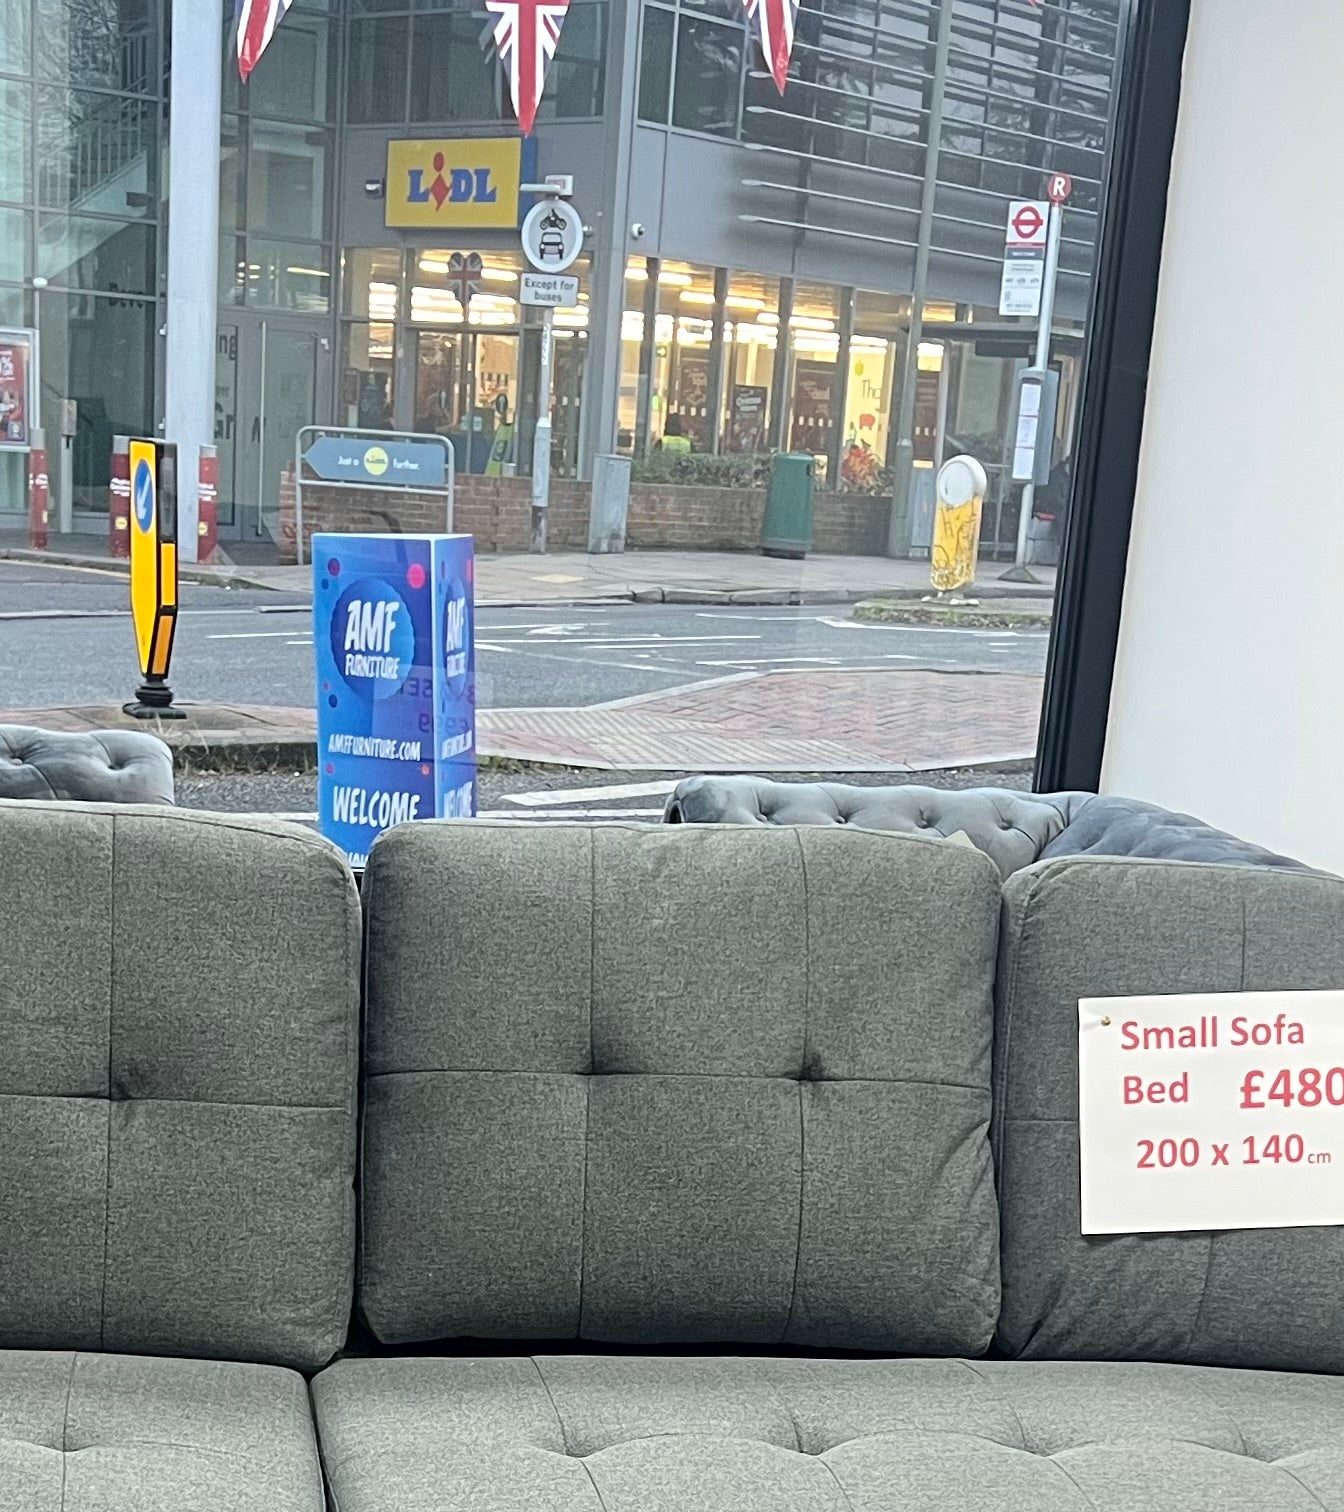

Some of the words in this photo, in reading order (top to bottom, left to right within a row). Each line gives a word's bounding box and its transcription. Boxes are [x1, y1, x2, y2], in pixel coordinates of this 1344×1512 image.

[1053, 176, 1066, 197] R
[524, 277, 558, 290] Except
[560, 279, 575, 291] for
[534, 291, 563, 303] buses
[344, 599, 400, 654] AMF
[344, 653, 401, 681] FURNITURE
[333, 785, 421, 828] WELCOME
[1121, 1016, 1218, 1050] Small
[1230, 1014, 1305, 1046] Sofa
[1123, 1071, 1189, 1105] Bed
[1136, 1137, 1200, 1169] 200
[1211, 1142, 1230, 1167] x
